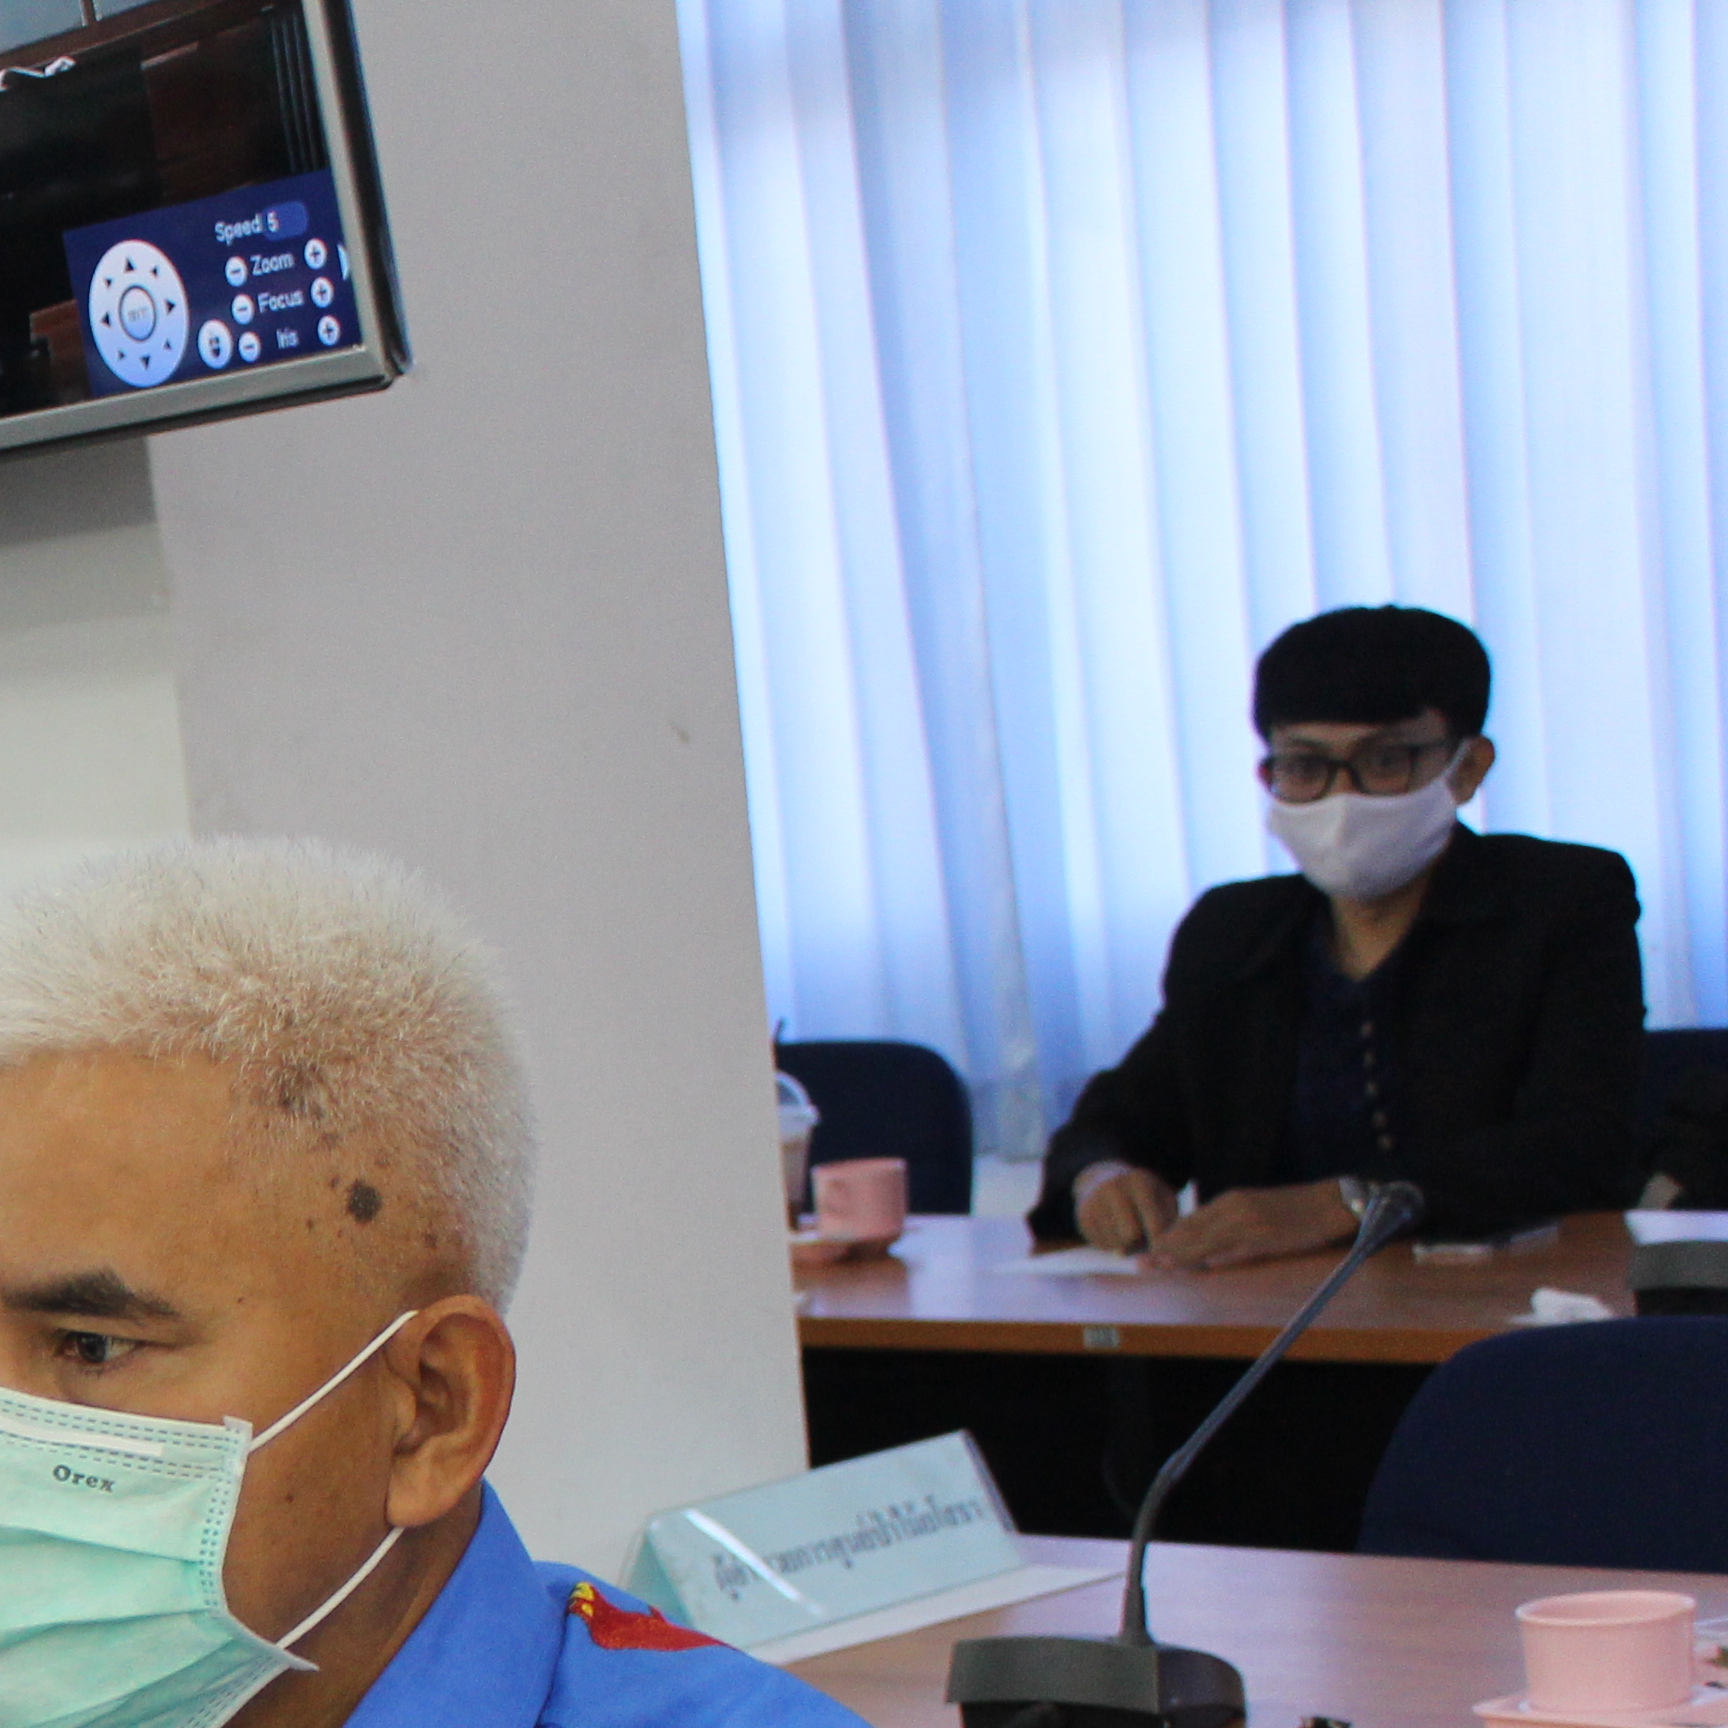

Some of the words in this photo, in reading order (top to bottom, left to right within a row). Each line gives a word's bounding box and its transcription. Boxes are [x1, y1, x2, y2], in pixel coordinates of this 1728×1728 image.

[216, 213, 261, 245] Speed
[267, 211, 279, 232] 5
[251, 254, 294, 276] Zoom
[258, 291, 303, 313] Focus
[277, 328, 298, 349] Iris
[53, 1464, 115, 1492] Orex
